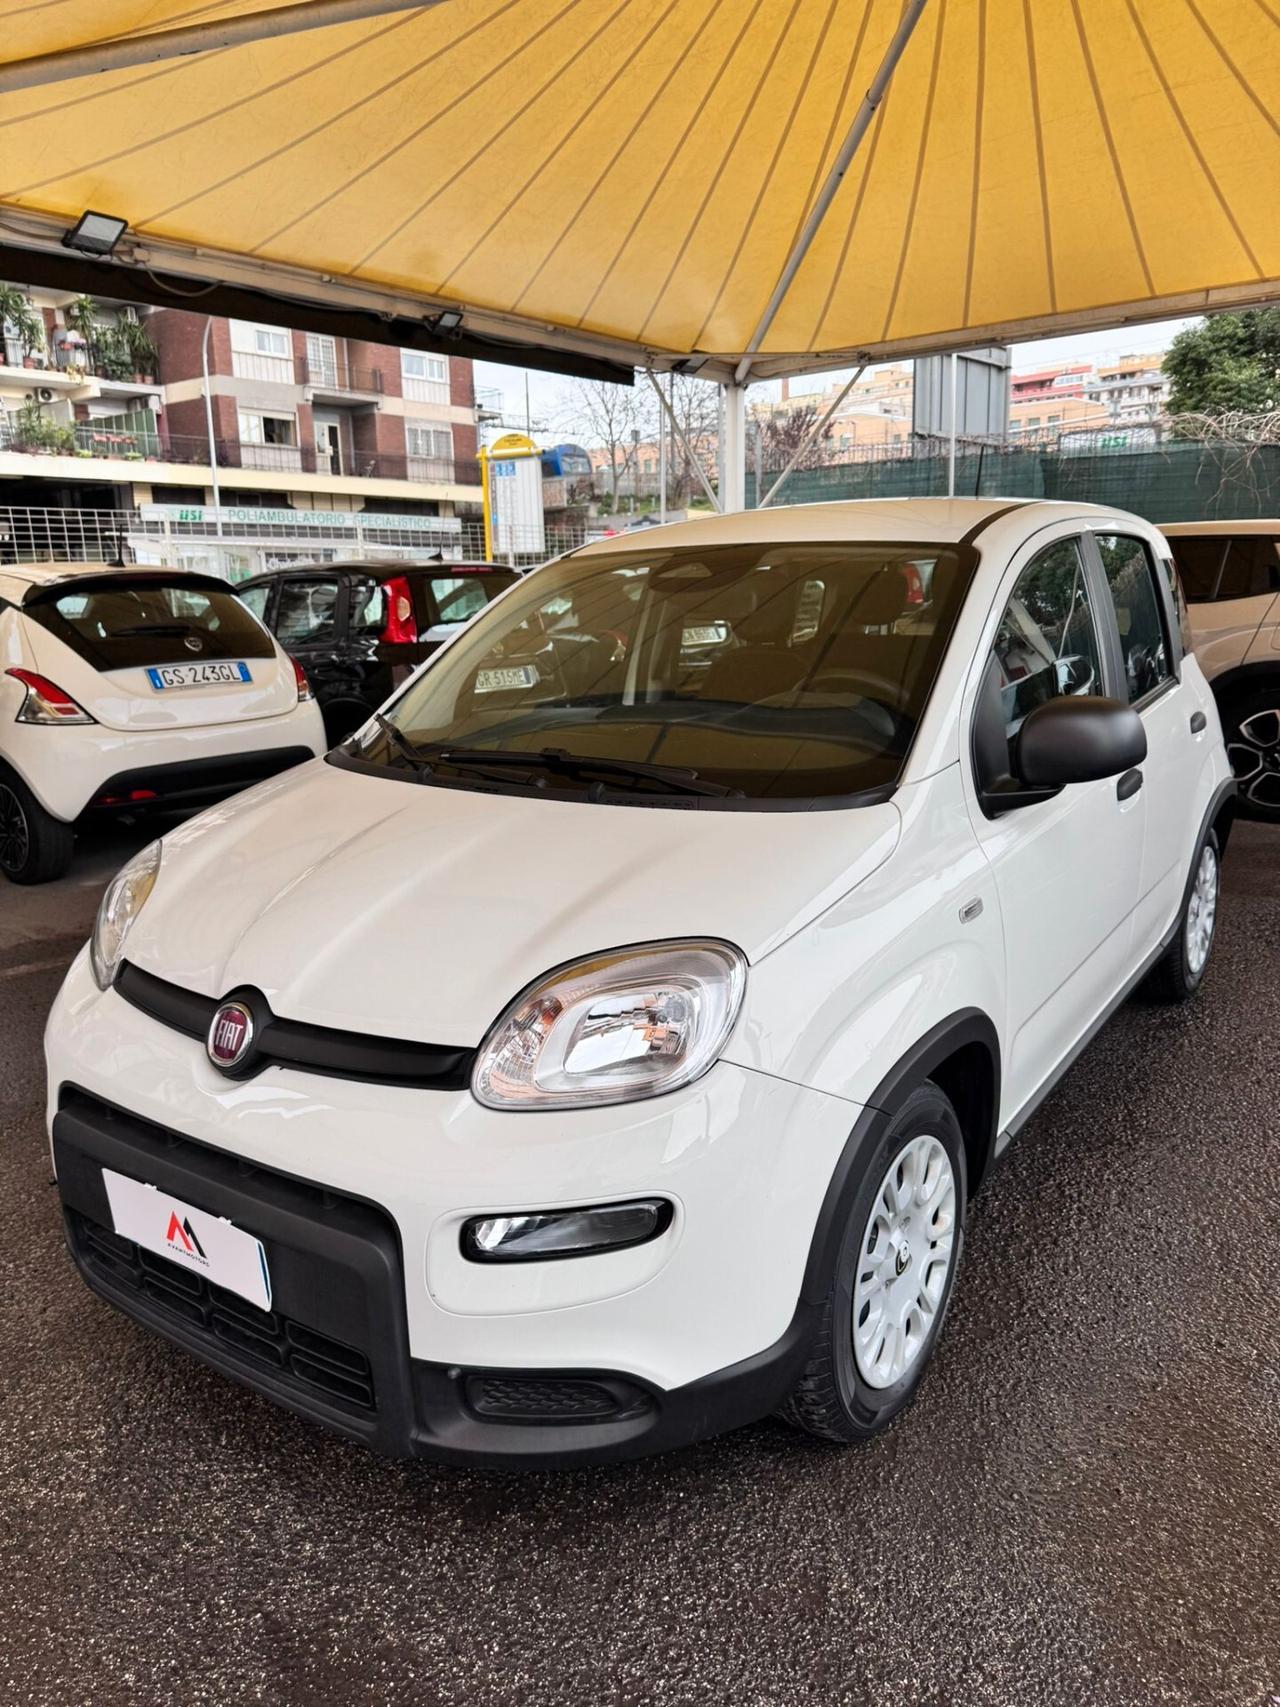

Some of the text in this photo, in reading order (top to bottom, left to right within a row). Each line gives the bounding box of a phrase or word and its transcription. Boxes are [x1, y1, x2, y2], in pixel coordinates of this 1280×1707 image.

[228, 509, 346, 525] POLIAMBULATORIO
[161, 665, 241, 686] GS 243GL
[215, 1019, 244, 1051] FIAT
